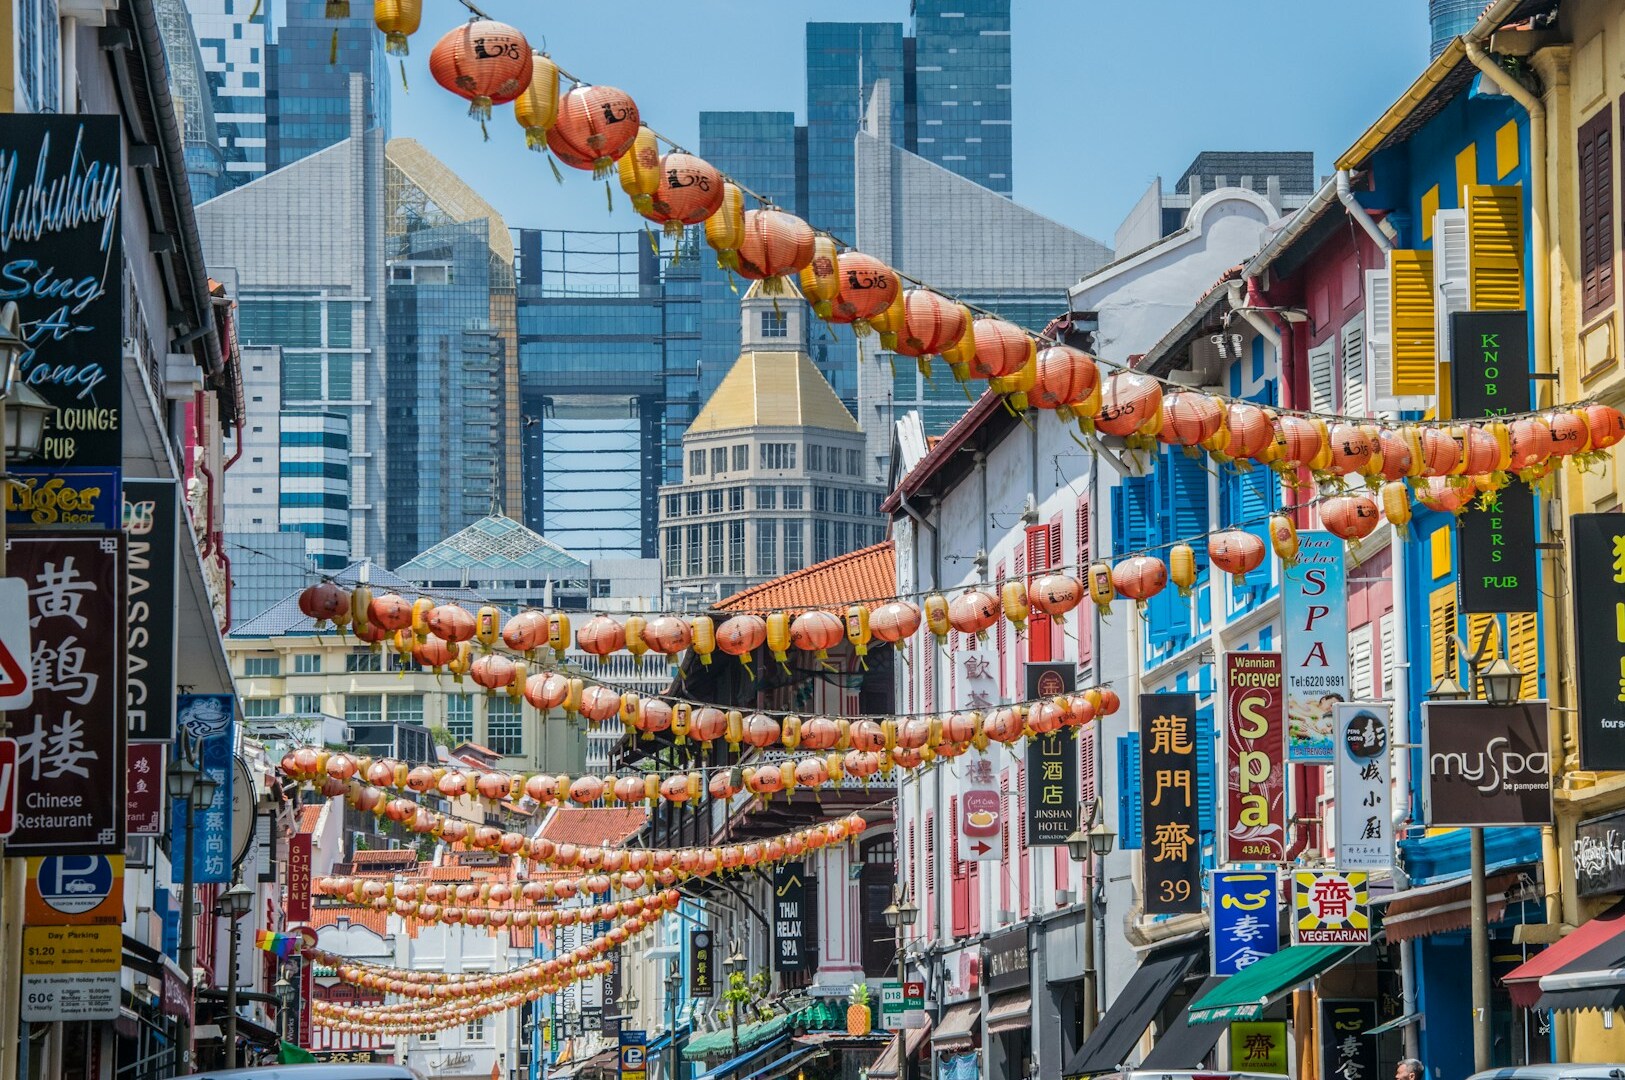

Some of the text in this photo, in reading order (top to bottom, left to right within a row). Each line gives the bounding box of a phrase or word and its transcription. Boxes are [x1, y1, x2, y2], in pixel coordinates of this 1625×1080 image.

[1481, 334, 1501, 396] KNOB
[56, 408, 119, 432] LOUNGE
[44, 436, 76, 460] PUB
[6, 479, 101, 524] Tiger
[62, 512, 95, 524] Beer
[1482, 576, 1519, 588] PUB
[1301, 569, 1330, 667] SPA
[127, 543, 152, 733] MASSAGE
[1234, 657, 1276, 669] Wannian
[1230, 669, 1282, 688] Forever
[1325, 675, 1345, 687] 9891
[963, 655, 995, 785] 飲茶樓
[1042, 733, 1064, 804] 山酒店
[1239, 696, 1271, 827] Spa
[1502, 782, 1549, 792] be pampered
[26, 793, 83, 809] Chinese
[15, 812, 93, 829] Restaurant
[1034, 810, 1073, 821] JINSHAN
[1038, 822, 1069, 832] HOTEL
[1241, 844, 1272, 855] 43A/B
[55, 856, 99, 895] P
[291, 845, 300, 901] GOLDEN
[301, 855, 309, 911] TRAVEL
[1159, 880, 1191, 903] 39
[779, 902, 798, 918] THAI
[48, 931, 99, 941] Day Parking
[777, 921, 802, 938] RELAX
[1299, 930, 1368, 942] VEGETARIAN
[28, 947, 55, 956] $1.20
[782, 940, 798, 957] SPA
[884, 992, 901, 1000] D18
[885, 1016, 891, 1026] 1
[1477, 1008, 1485, 1022] 7
[183, 1050, 190, 1063] 8
[430, 1051, 473, 1068] Adler
